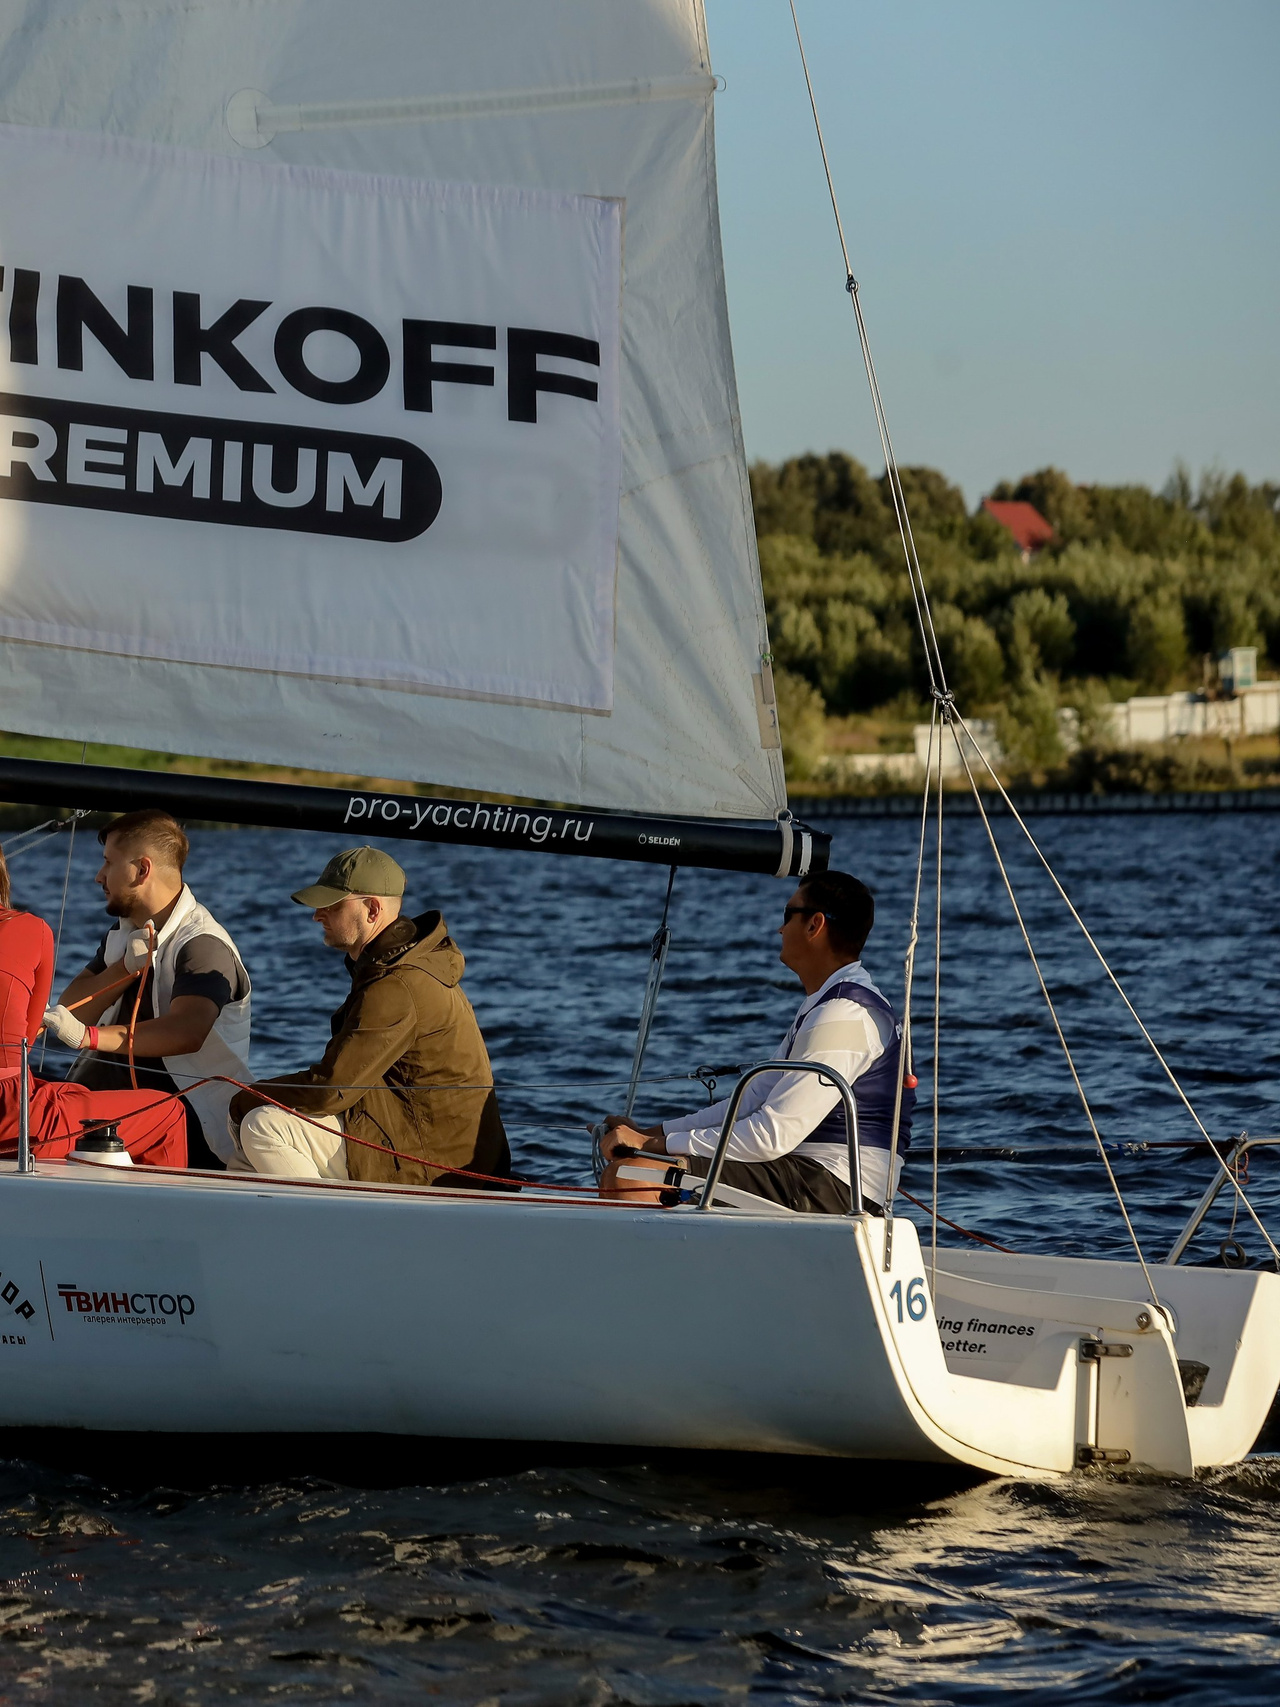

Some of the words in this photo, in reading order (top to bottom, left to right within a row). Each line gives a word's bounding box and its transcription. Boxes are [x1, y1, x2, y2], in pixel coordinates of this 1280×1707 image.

[344, 796, 594, 842] pro-yachting.ru
[889, 1277, 927, 1323] 16
[83, 1315, 116, 1325] галерея
[117, 1316, 167, 1326] интерьеров
[936, 1316, 963, 1334] ing
[967, 1318, 1035, 1336] finances
